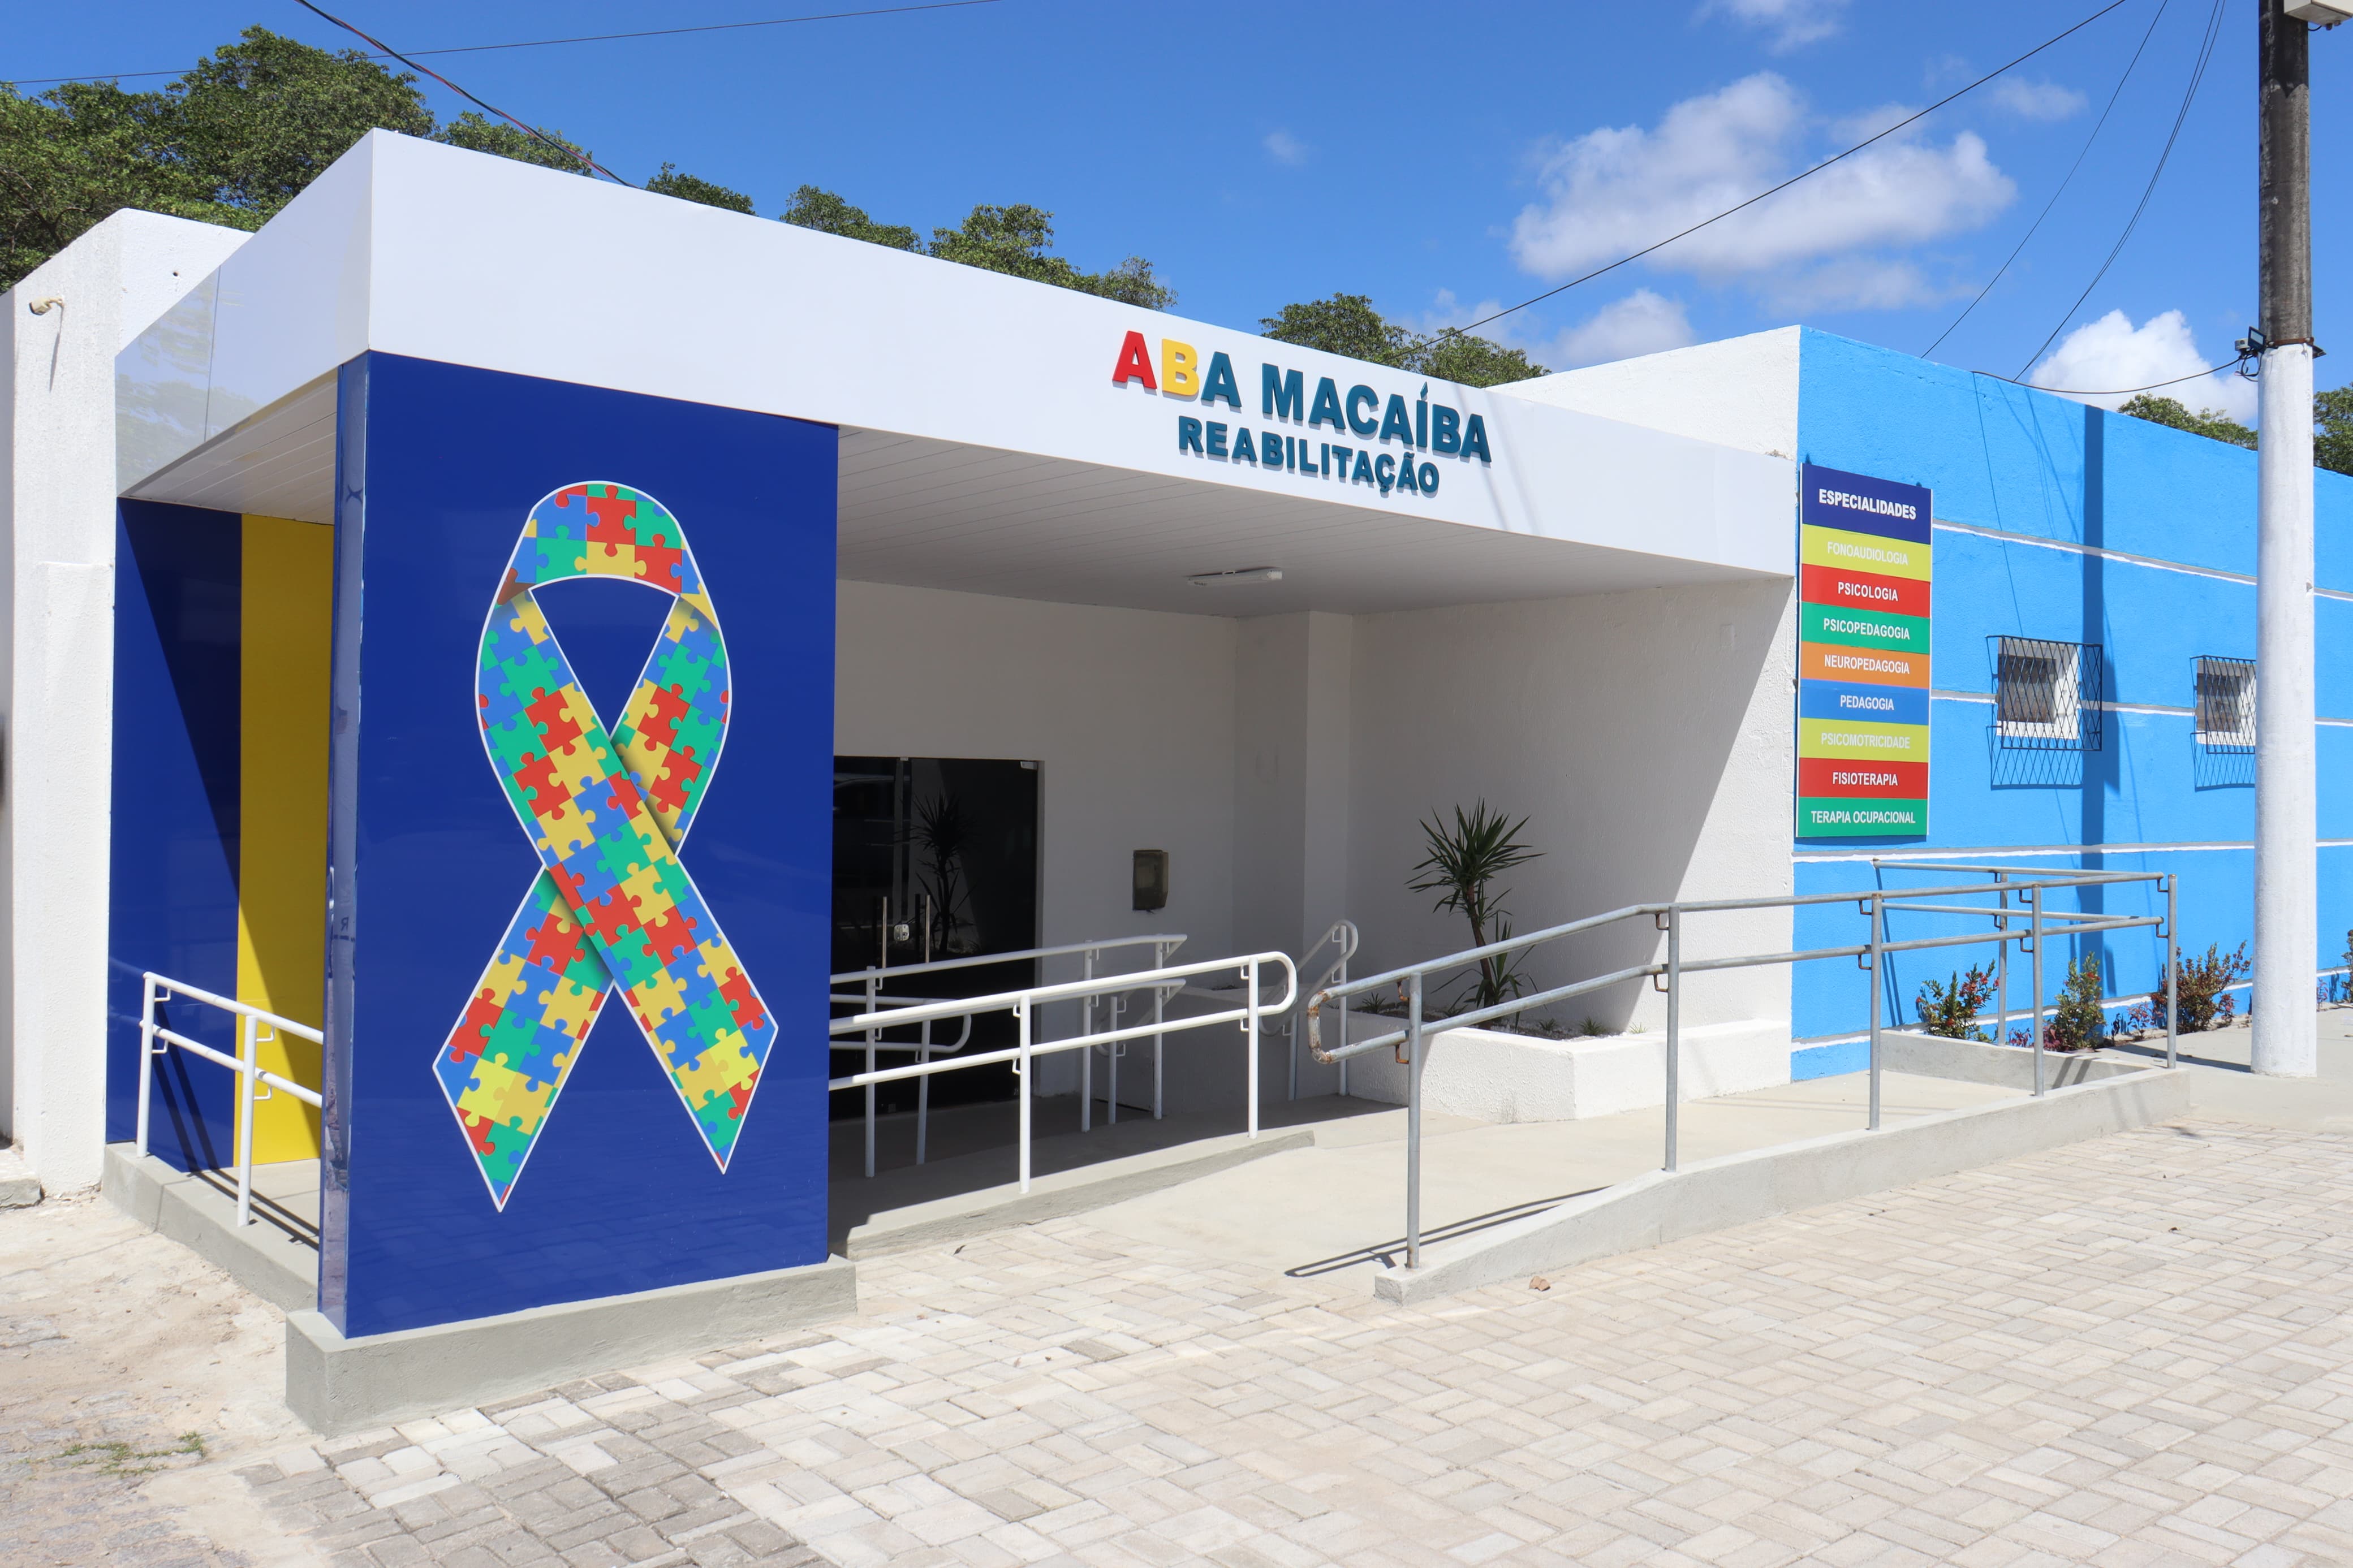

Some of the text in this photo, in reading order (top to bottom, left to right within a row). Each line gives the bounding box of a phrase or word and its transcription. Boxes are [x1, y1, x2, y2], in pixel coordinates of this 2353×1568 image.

[1112, 330, 1492, 463] ABA MACAÍBA
[1178, 416, 1440, 494] REABILITAÇÃO
[1818, 488, 1917, 520] ESPECIALIDADES
[1828, 541, 1908, 565] FONOAUDIOLOGIA
[1838, 581, 1898, 601] PSICOLOGIA
[1823, 617, 1910, 640] PSICOPEDAGOGIA
[1824, 654, 1910, 674] NEUROPEDAGOGIA
[1840, 695, 1894, 711] PEDAGOGIA
[1821, 732, 1910, 749] PSICOMOTRICIDADE
[1833, 772, 1898, 786] FISIOTERAPIA
[1811, 810, 1916, 824] TERAPIA OCUPACIONAL
